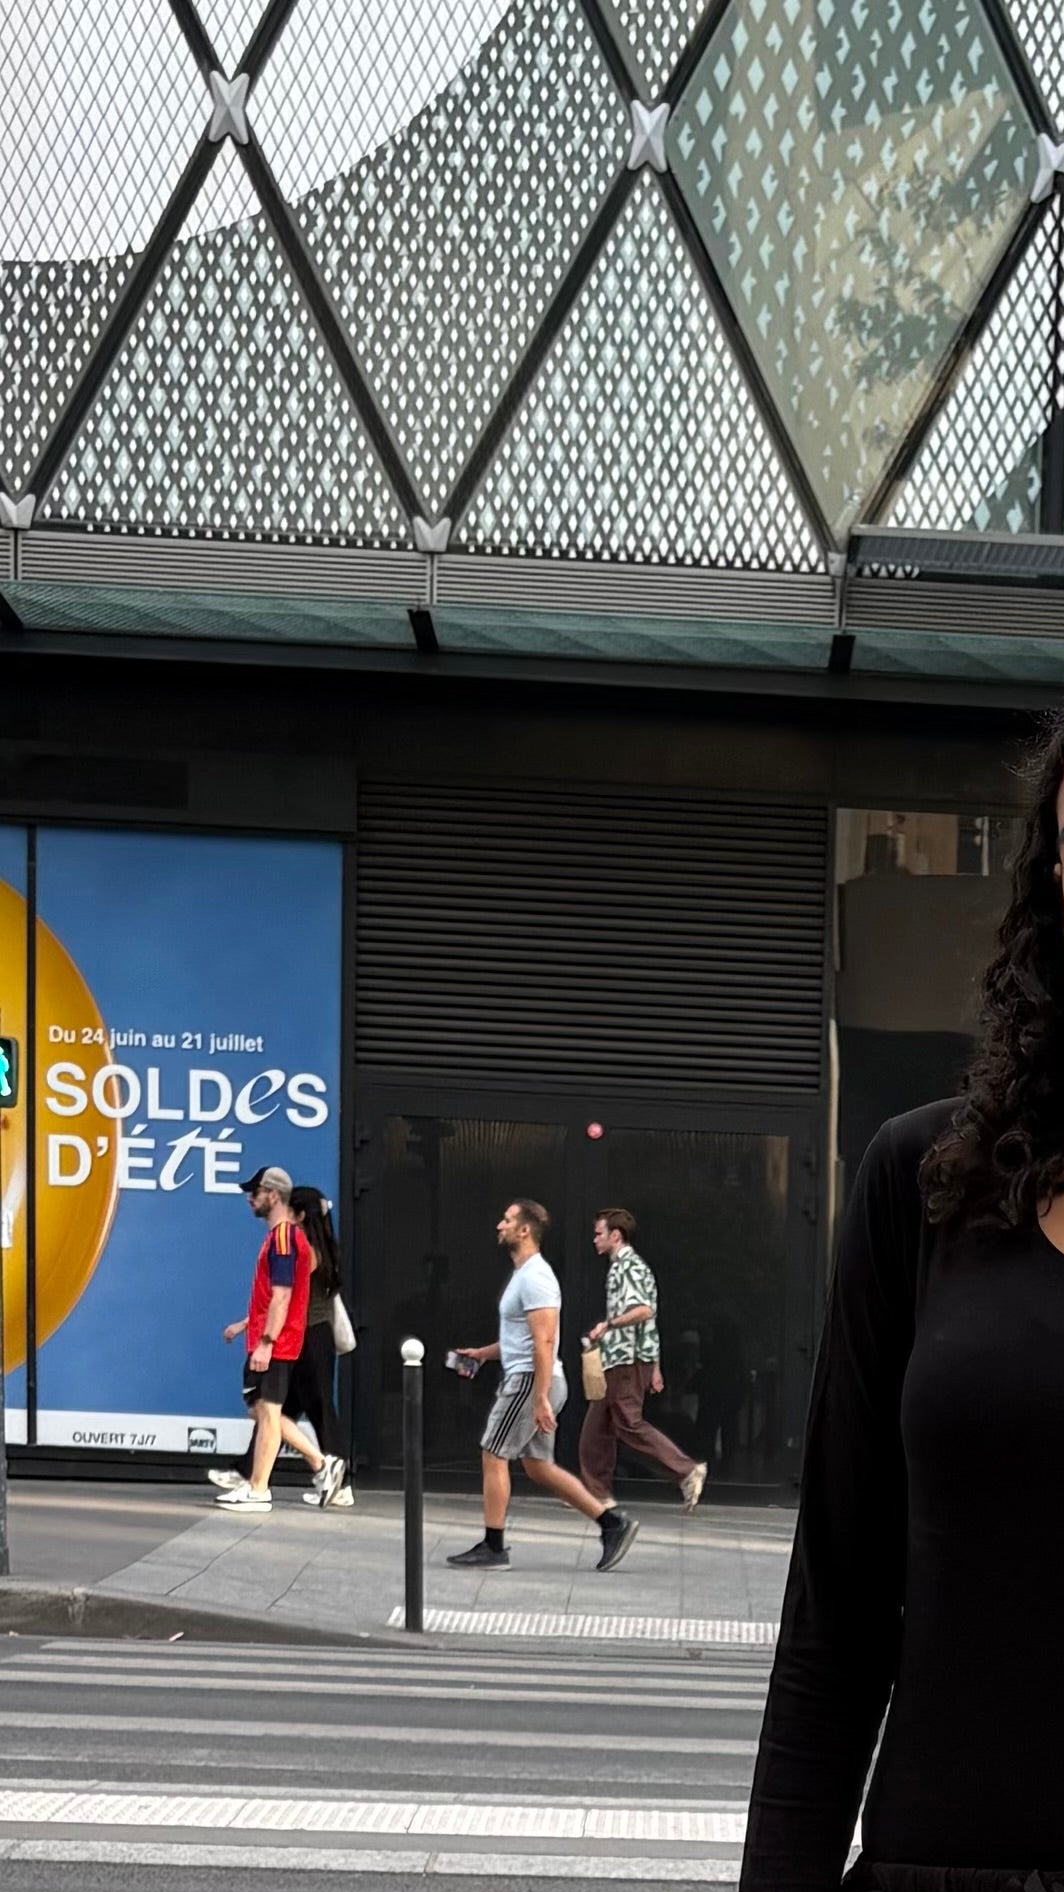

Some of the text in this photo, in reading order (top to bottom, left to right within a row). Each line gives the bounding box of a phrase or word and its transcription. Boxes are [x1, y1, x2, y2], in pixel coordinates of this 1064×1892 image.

[48, 1025, 264, 1054] Du 24 juin au 21 juillet
[72, 1431, 157, 1446] OUVERT 7J/7
